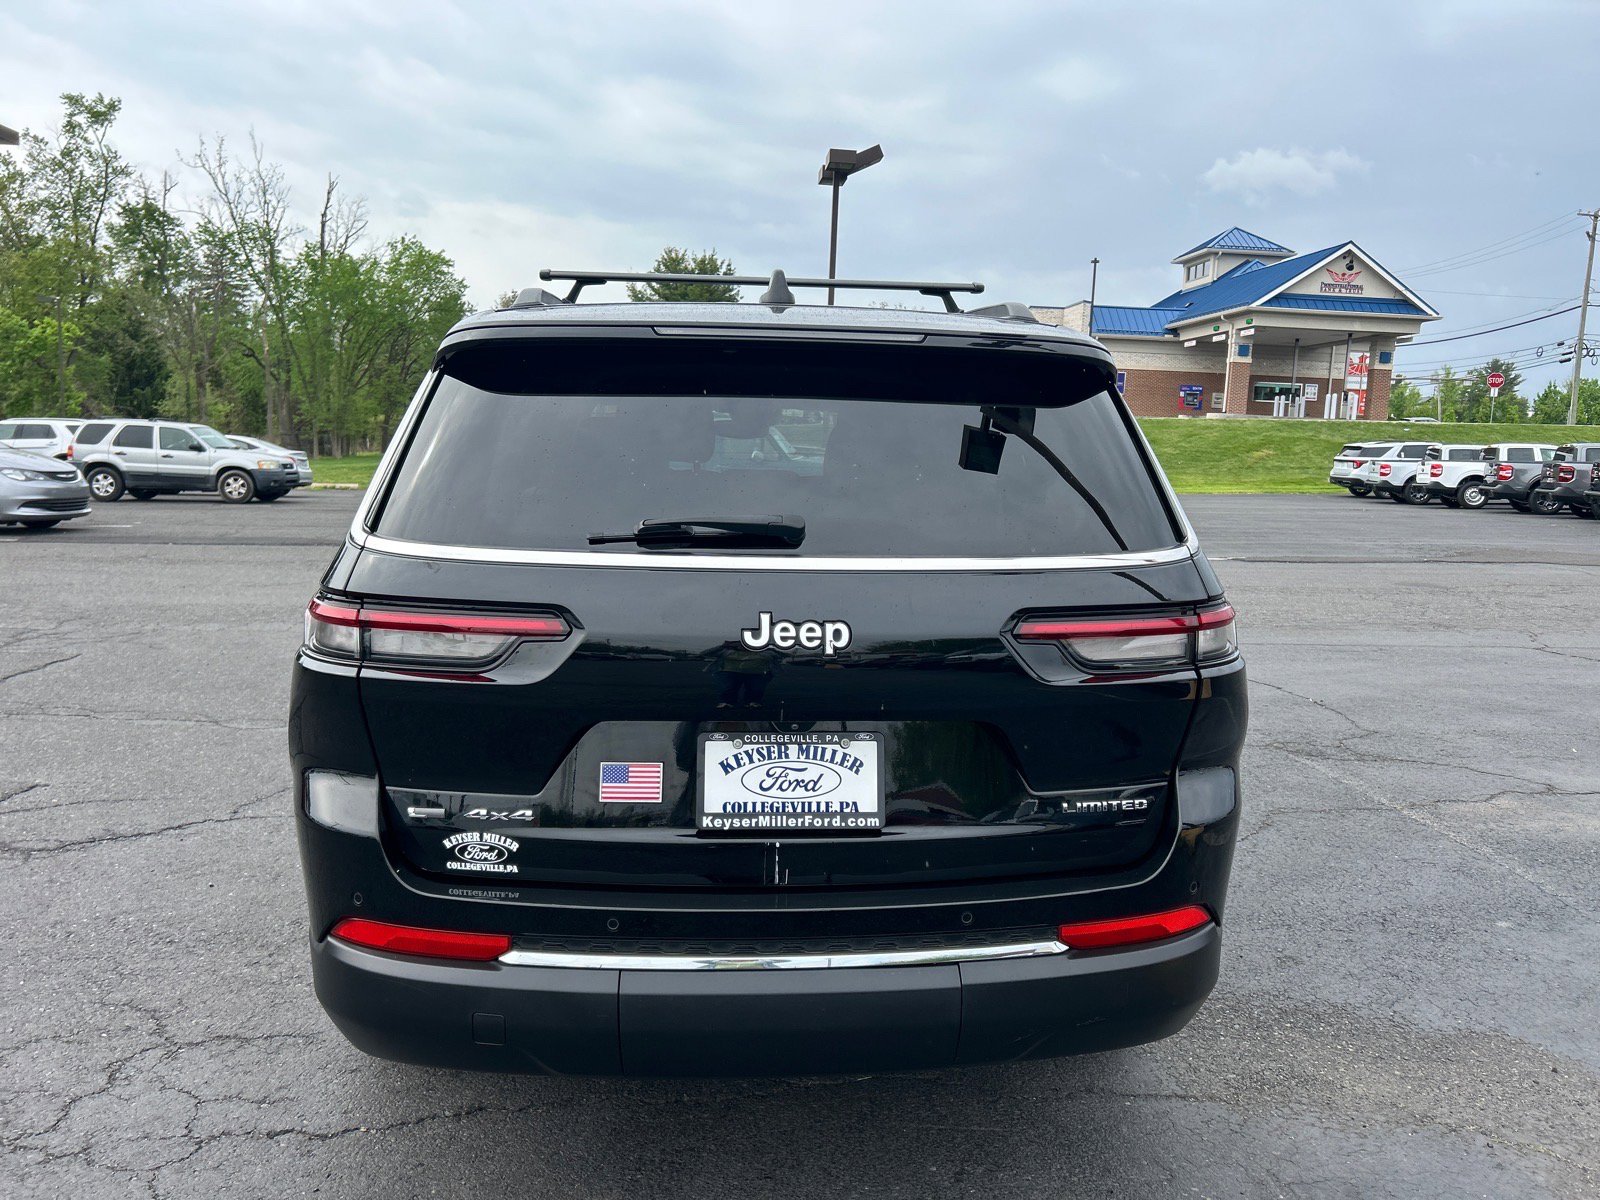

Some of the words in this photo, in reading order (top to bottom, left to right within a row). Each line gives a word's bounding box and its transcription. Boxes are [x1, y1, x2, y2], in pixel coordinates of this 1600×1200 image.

[742, 611, 851, 656] Jeep
[744, 734, 822, 743] COLLEGEVILLE,
[825, 734, 839, 743] PA
[718, 745, 790, 776] KEYSER
[797, 743, 865, 776] MILLER
[759, 766, 824, 792] Ford
[1062, 799, 1148, 813] LIMITED
[464, 809, 535, 821] 4x4
[702, 815, 880, 830] KeyserMillerFord.com
[442, 832, 481, 849] KEYSER
[482, 832, 520, 852] MILLER
[464, 844, 498, 860] Ford
